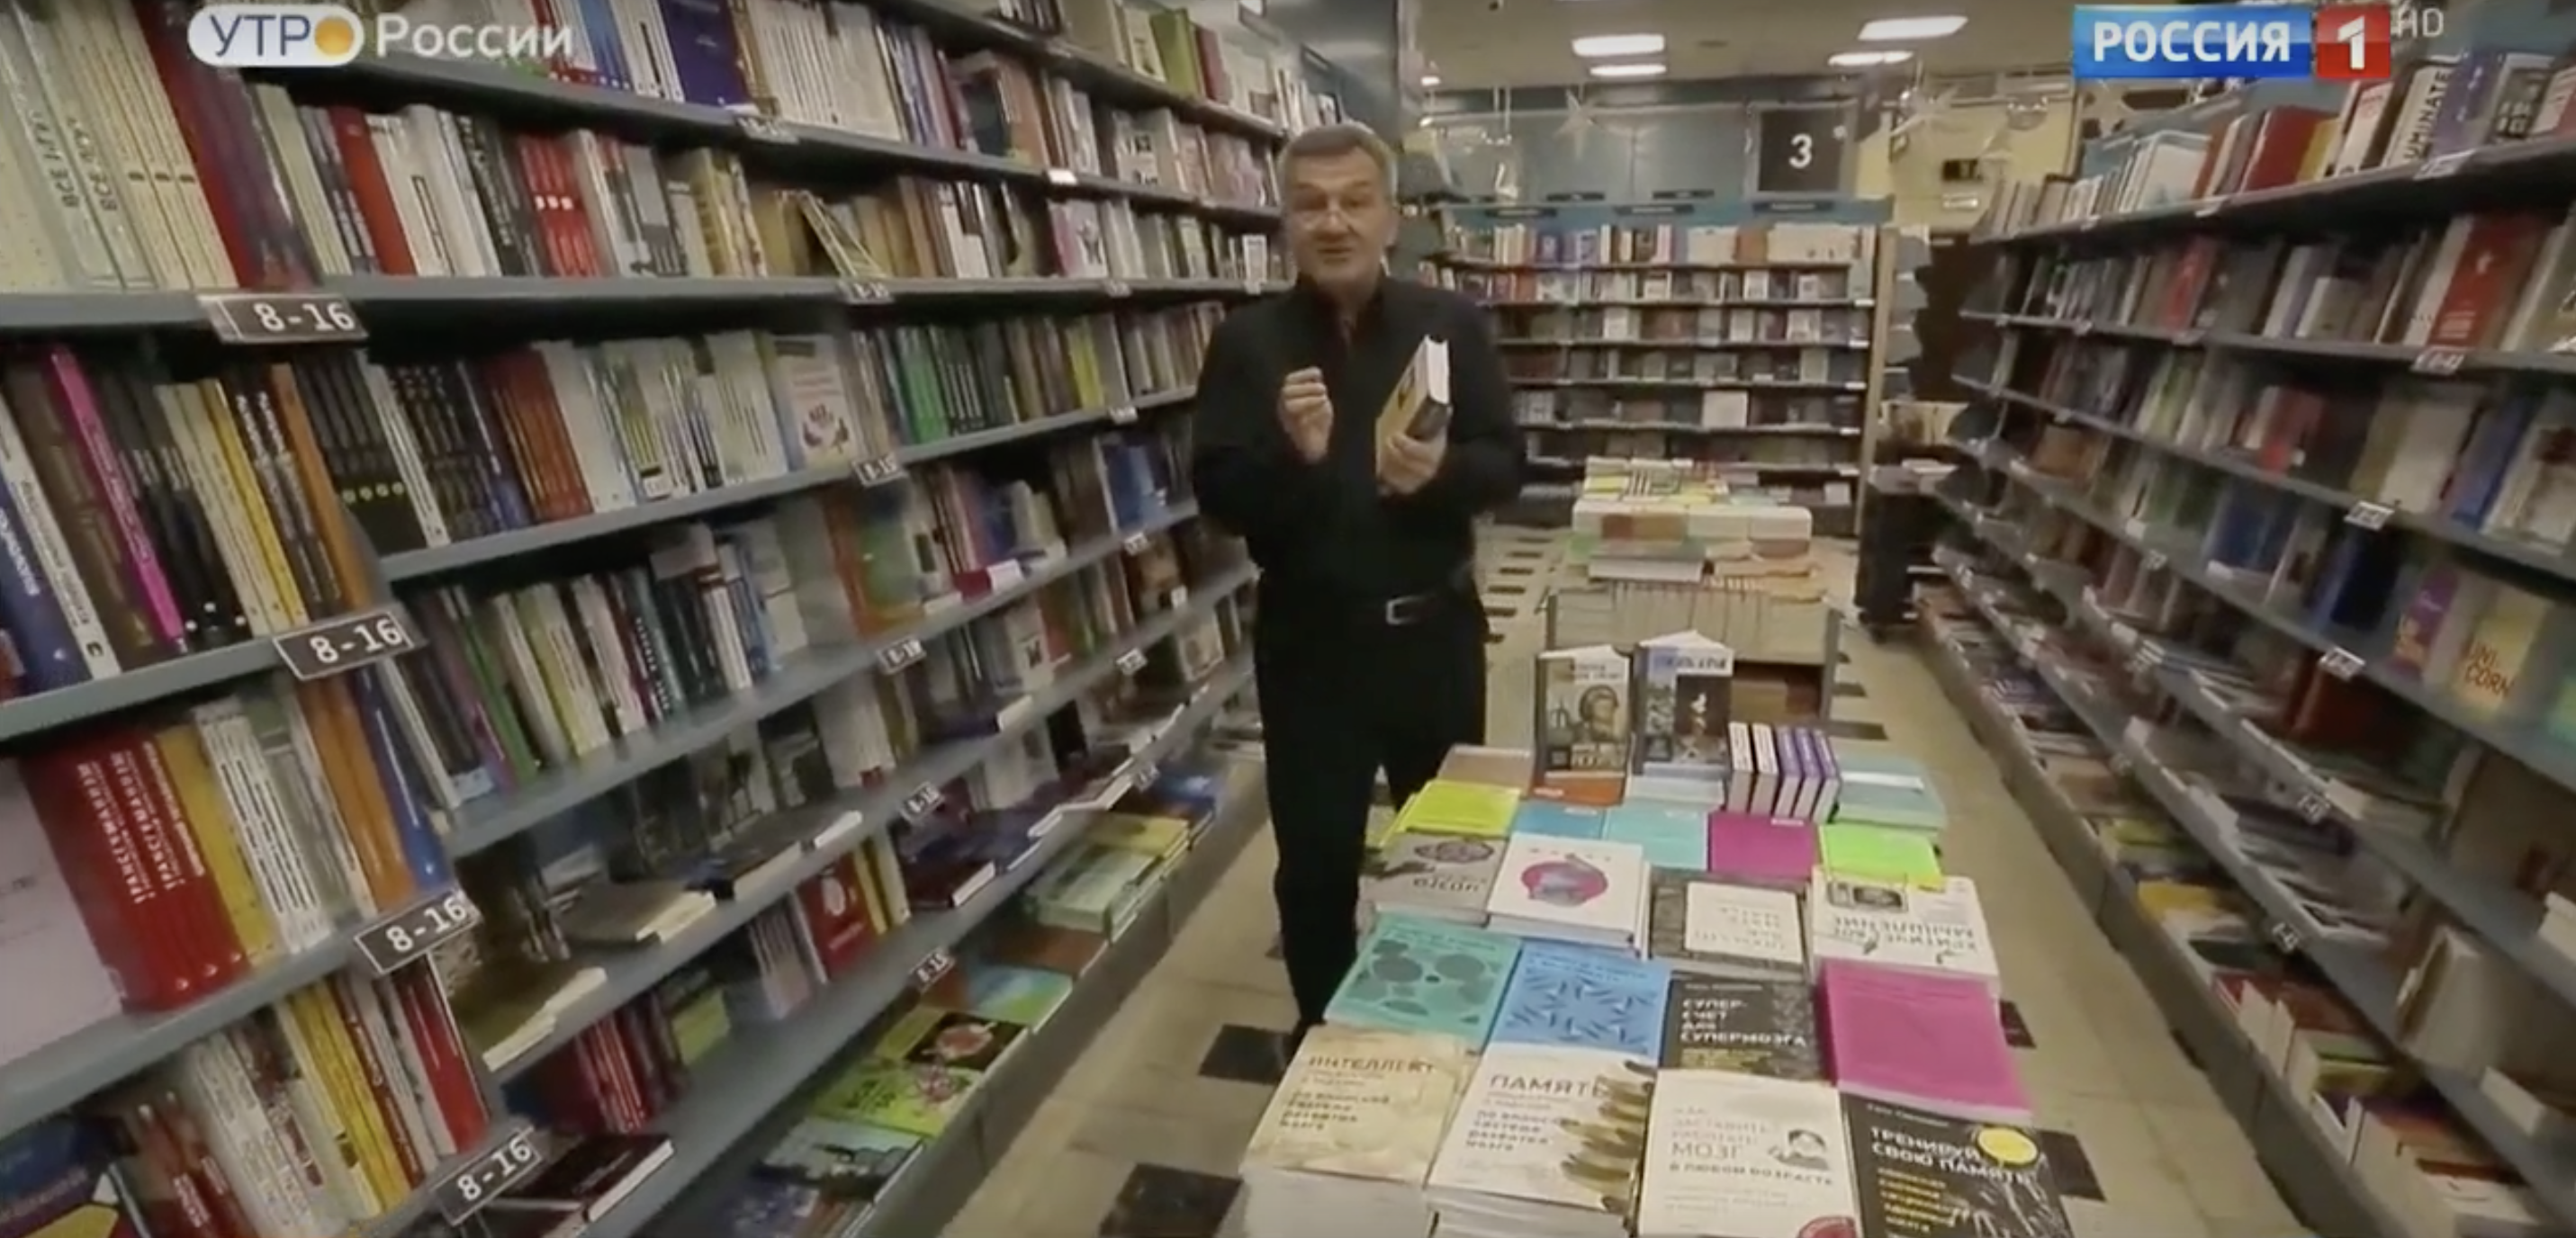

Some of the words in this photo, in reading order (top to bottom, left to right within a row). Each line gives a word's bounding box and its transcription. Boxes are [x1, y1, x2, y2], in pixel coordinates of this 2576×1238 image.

[1788, 132, 1813, 169] 3
[253, 301, 355, 332] 8-16
[310, 618, 403, 664] 8-16
[385, 896, 466, 952] 8-16
[1308, 1055, 1437, 1073] ИНТЕЛЛЕКТ
[1490, 1074, 1609, 1099] ПАМЯТЬ
[1671, 1142, 1743, 1160] МОЗГ
[1870, 1126, 1982, 1161] ТРЕНИРУЙ
[1872, 1142, 1934, 1167] СВОЮ
[456, 1136, 532, 1201] 8-16
